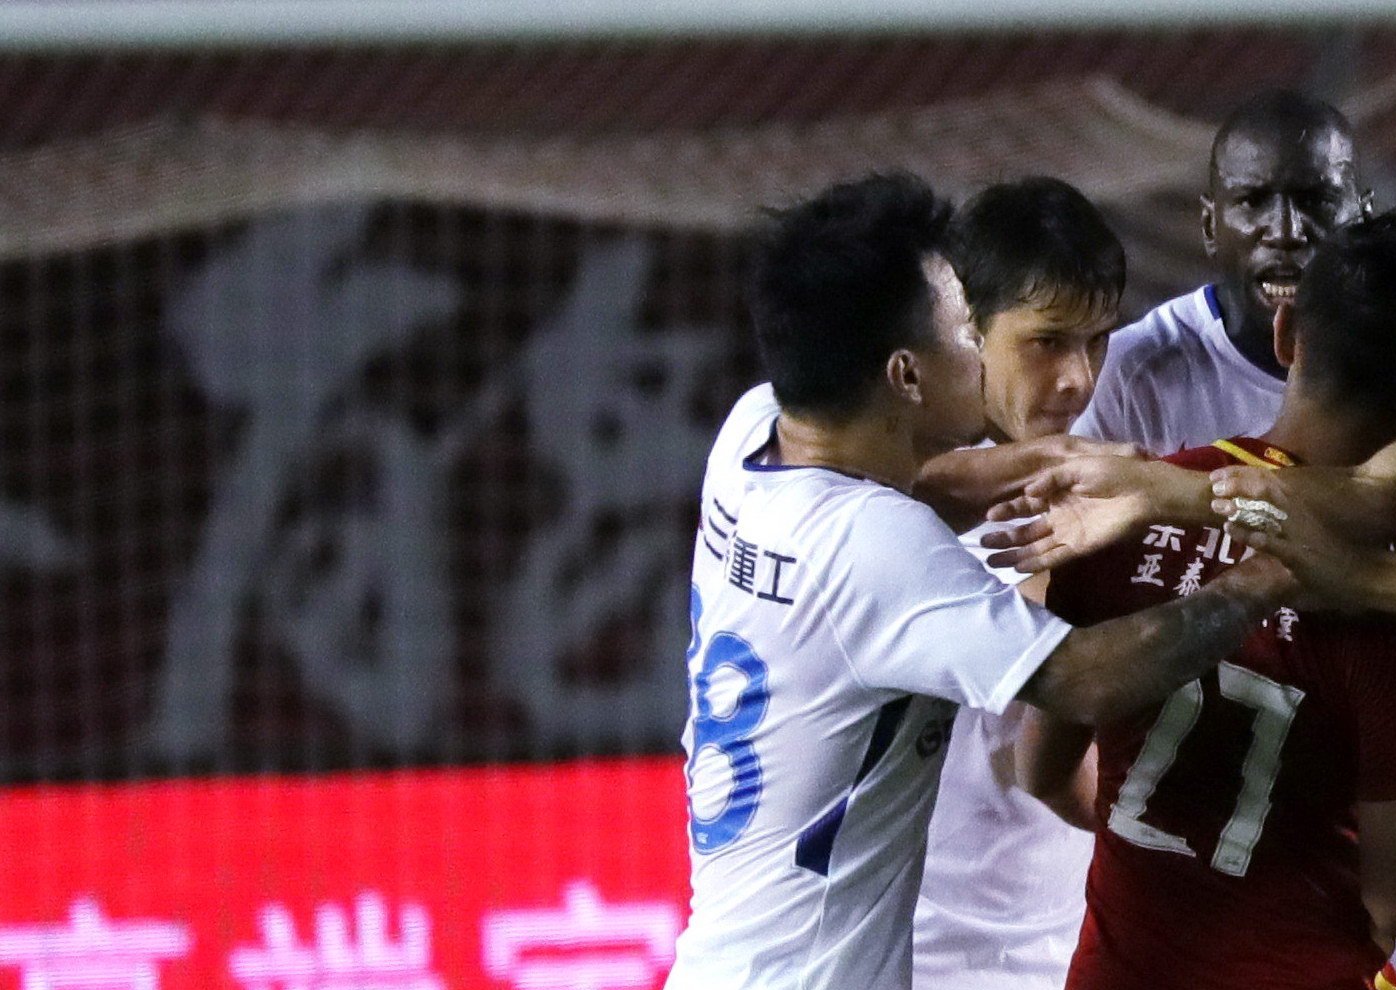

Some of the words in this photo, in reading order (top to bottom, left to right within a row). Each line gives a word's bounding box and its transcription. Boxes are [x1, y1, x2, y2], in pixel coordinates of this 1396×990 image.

[704, 498, 797, 606] 三重工
[687, 585, 770, 854] 8
[1107, 660, 1306, 877] 27
